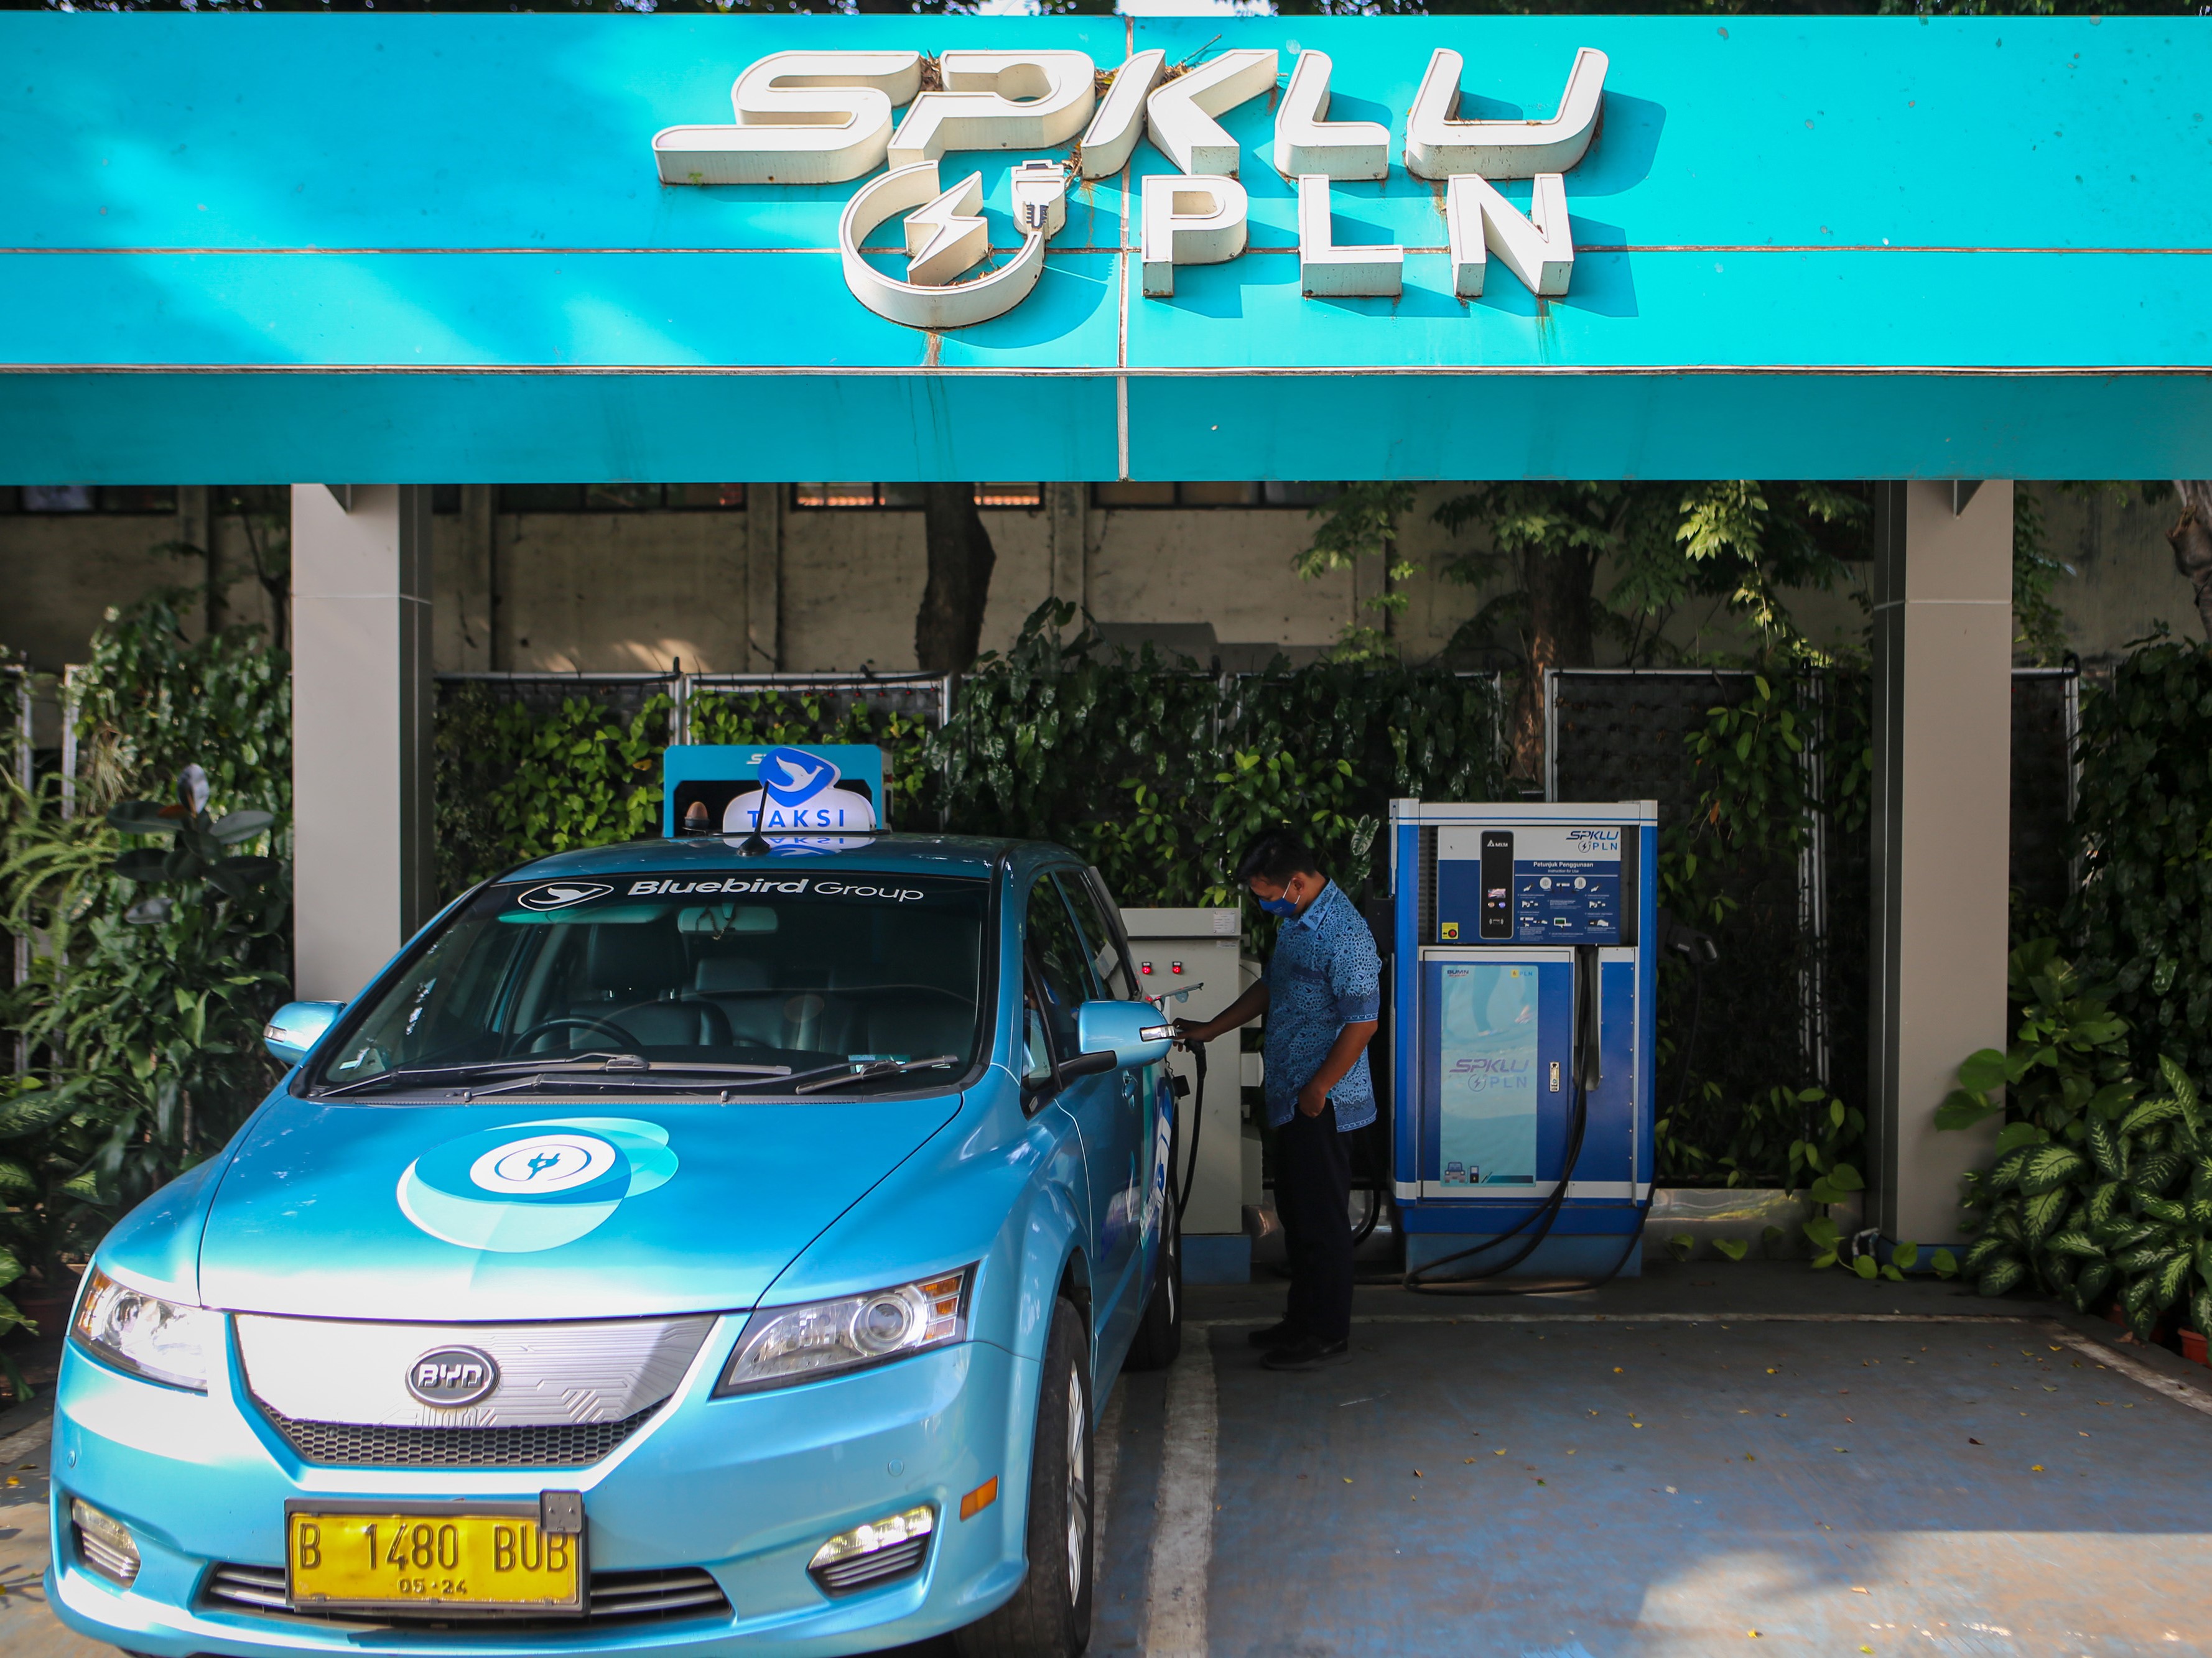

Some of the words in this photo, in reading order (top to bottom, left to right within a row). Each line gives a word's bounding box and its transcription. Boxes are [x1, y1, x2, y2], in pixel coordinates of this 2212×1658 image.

[652, 47, 1609, 185] SPKLU
[1141, 172, 1574, 298] PLN
[747, 809, 844, 828] TAKSI
[1566, 830, 1619, 840] SPKLU
[1592, 842, 1618, 851] PLN
[627, 878, 809, 896] Bluebird
[814, 881, 924, 902] Group
[1449, 1058, 1530, 1073] SPKLU
[1490, 1076, 1527, 1088] PLN
[419, 1363, 485, 1388] BYD
[299, 1522, 322, 1570] B
[364, 1522, 459, 1571] 1480
[493, 1524, 569, 1573] BUB
